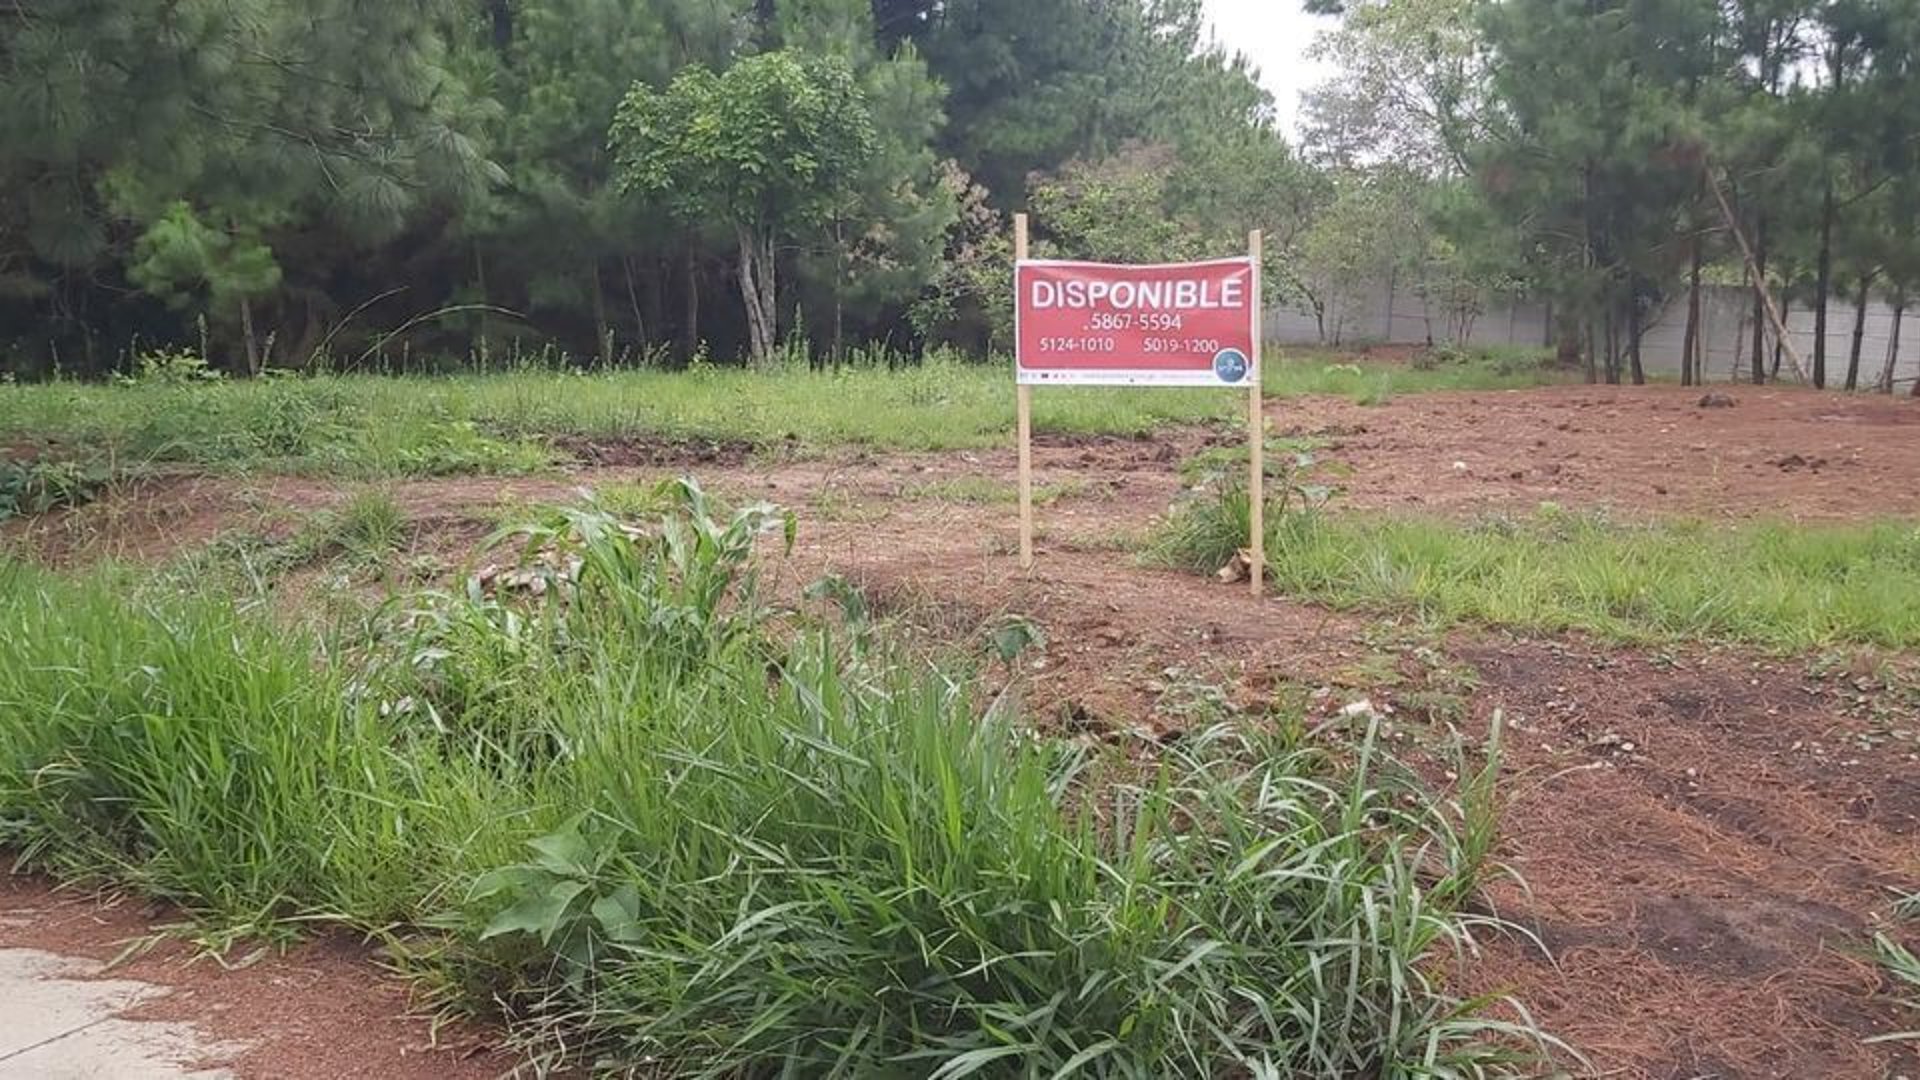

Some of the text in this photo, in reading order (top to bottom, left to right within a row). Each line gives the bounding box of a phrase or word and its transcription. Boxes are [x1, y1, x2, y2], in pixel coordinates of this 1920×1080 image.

[1032, 278, 1243, 308] DISPONIBLE
[1039, 337, 1219, 353] 5124-1010 5019-1200
